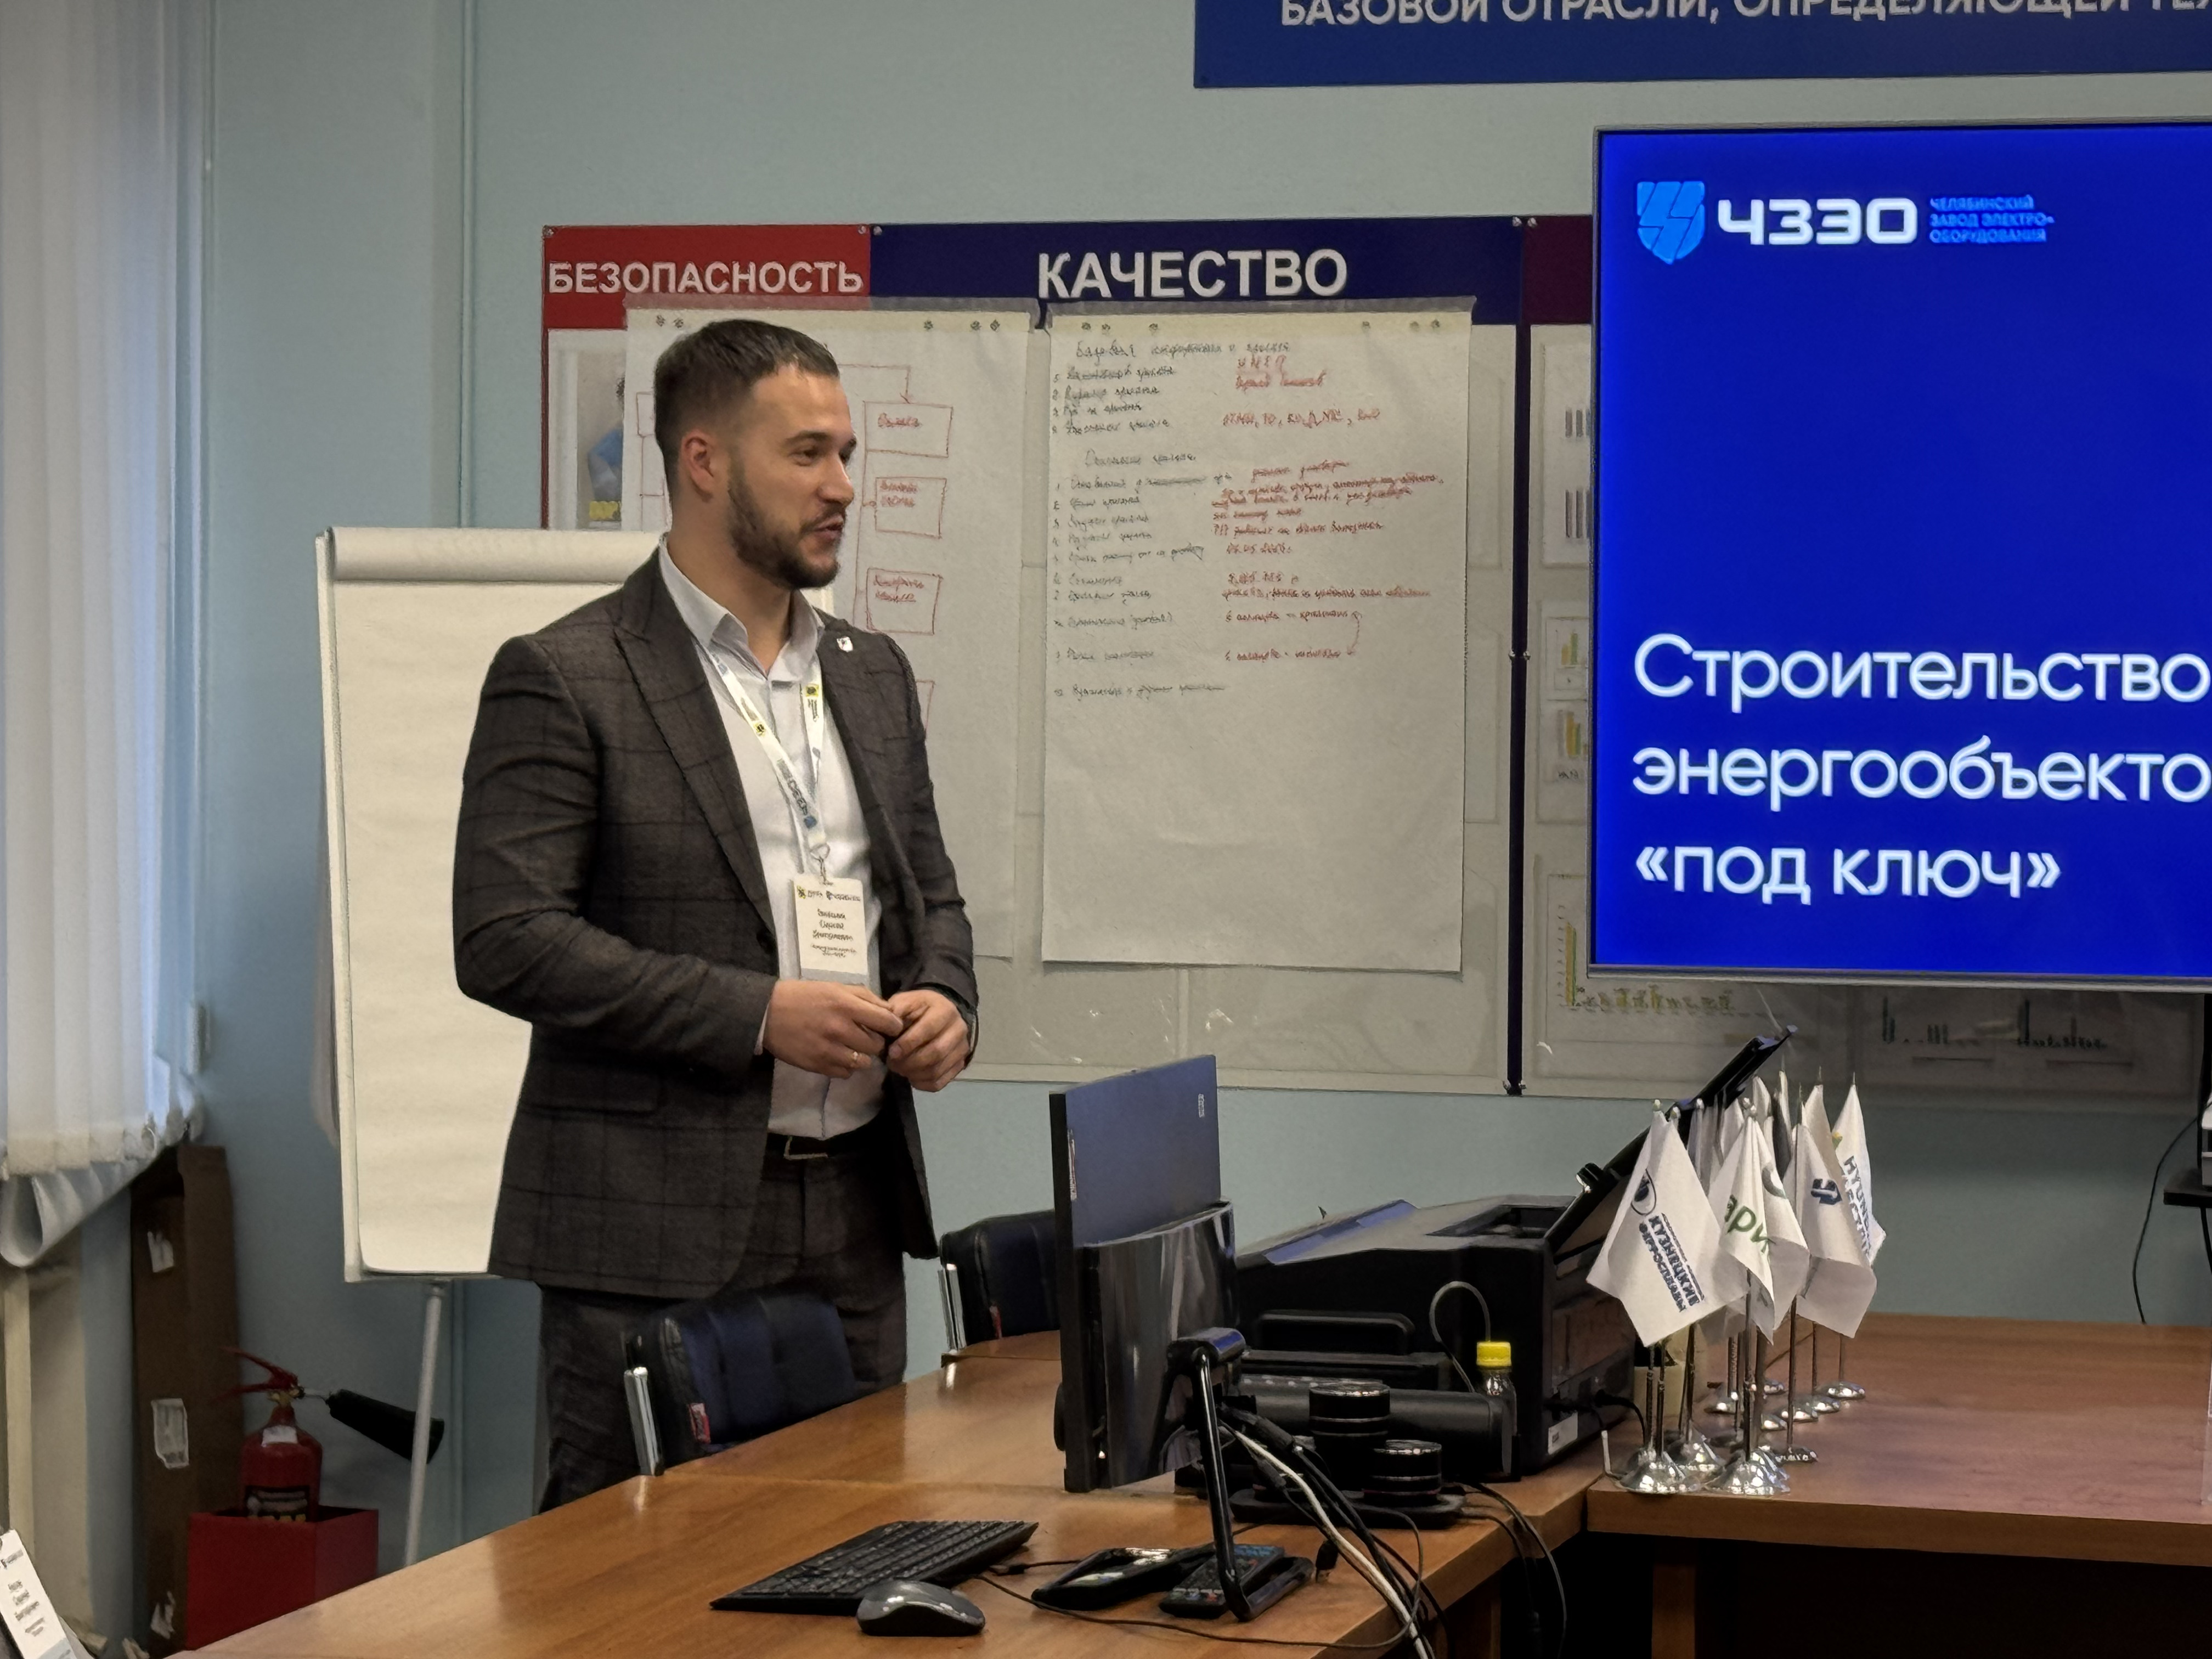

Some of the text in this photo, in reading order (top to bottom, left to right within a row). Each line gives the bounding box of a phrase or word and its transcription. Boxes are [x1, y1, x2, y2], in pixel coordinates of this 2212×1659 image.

[1929, 213, 1979, 228] ЗАВОД
[548, 261, 864, 295] БЕЗОПАСНОСТЬ
[1037, 249, 1349, 300] КАЧЕСТВО
[1633, 632, 2211, 714] Строительство
[1635, 845, 2062, 906] «под ключ»
